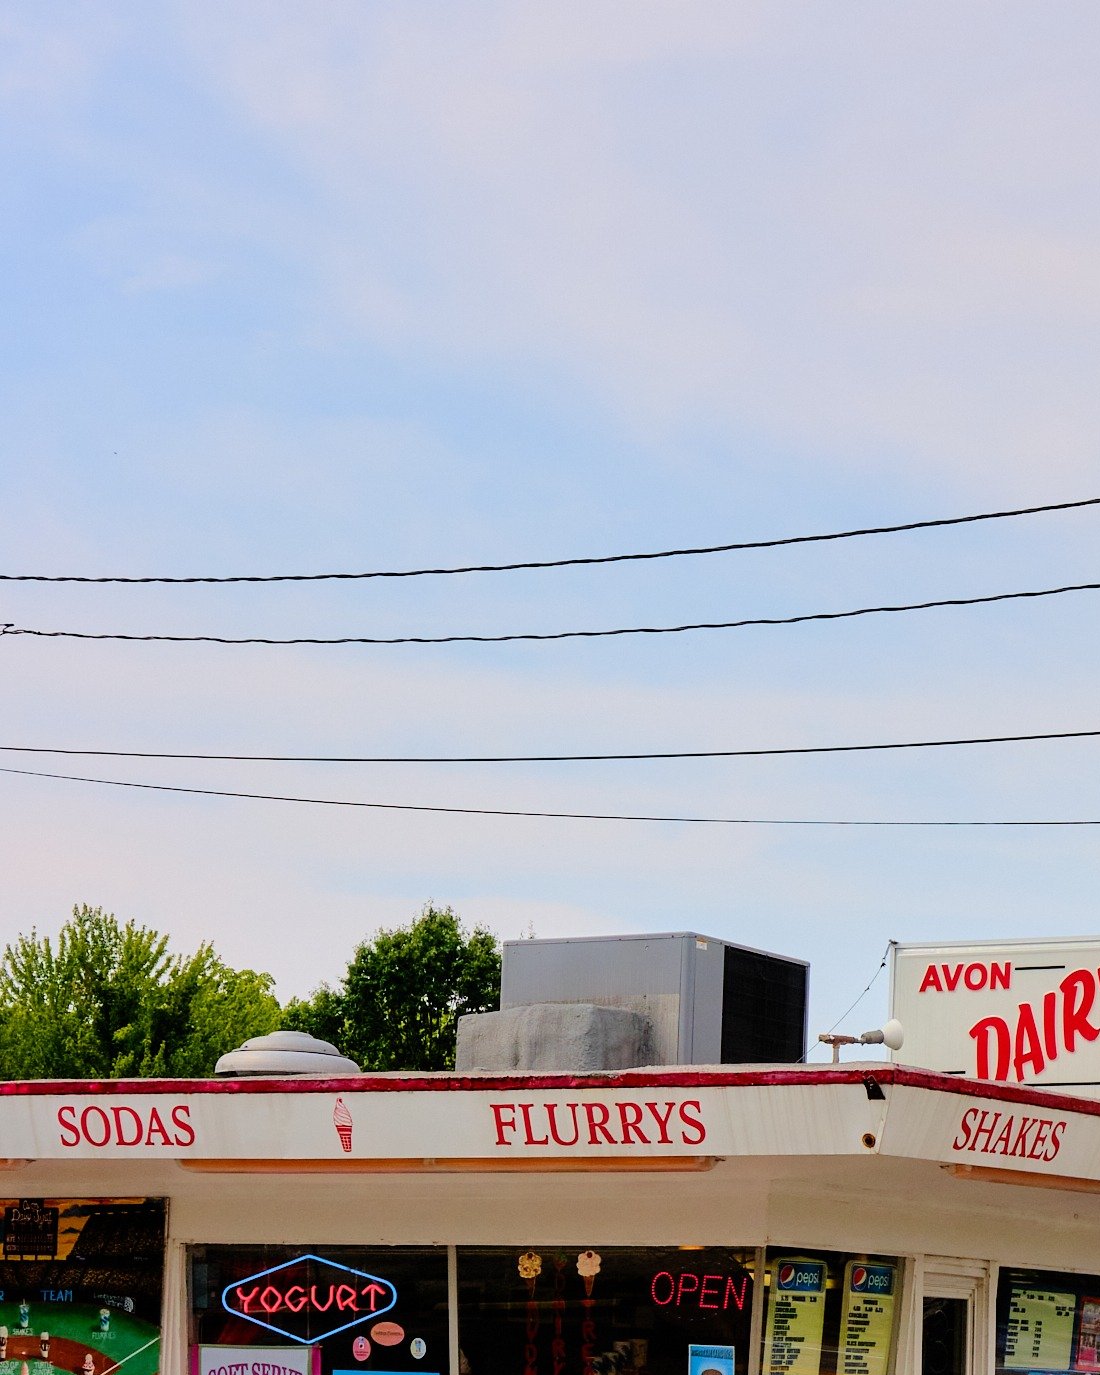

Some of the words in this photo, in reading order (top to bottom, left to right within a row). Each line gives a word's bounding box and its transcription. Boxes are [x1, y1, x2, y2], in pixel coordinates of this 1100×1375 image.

[919, 962, 1012, 992] AVON
[57, 1105, 196, 1147] SODAS
[489, 1100, 707, 1147] FLURRYS
[952, 1107, 1067, 1162] SHAKES
[651, 1271, 748, 1310] OPEN
[796, 1270, 820, 1286] pepsi
[868, 1273, 890, 1289] pepsi
[40, 1289, 73, 1302] TEAM
[236, 1283, 387, 1314] YOGURT
